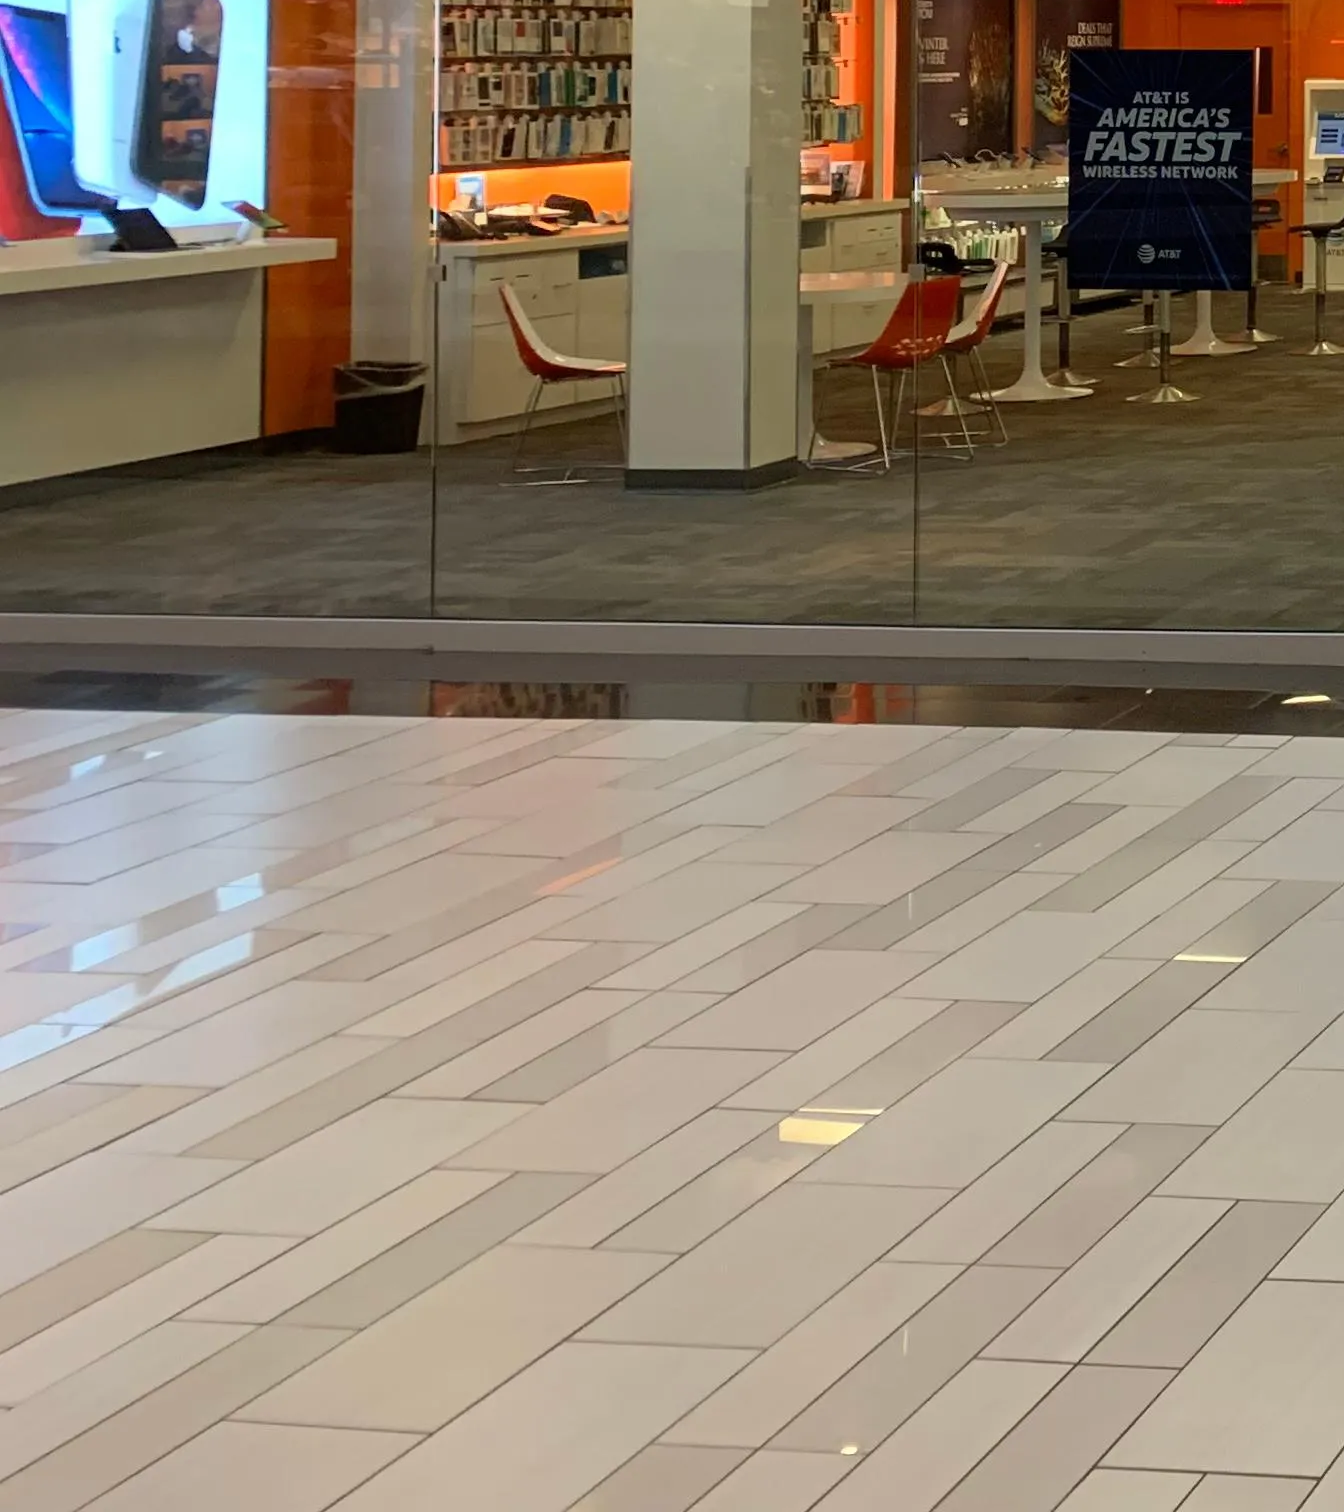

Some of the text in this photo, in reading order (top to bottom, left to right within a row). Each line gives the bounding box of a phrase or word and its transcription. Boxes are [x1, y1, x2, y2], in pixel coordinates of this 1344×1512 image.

[1132, 91, 1190, 104] AT&T IS
[1096, 107, 1231, 128] AMERICA'S
[1084, 131, 1242, 162] FASTEST
[1082, 165, 1239, 179] WIRELESS NETWORK
[1158, 249, 1181, 259] AT&T
